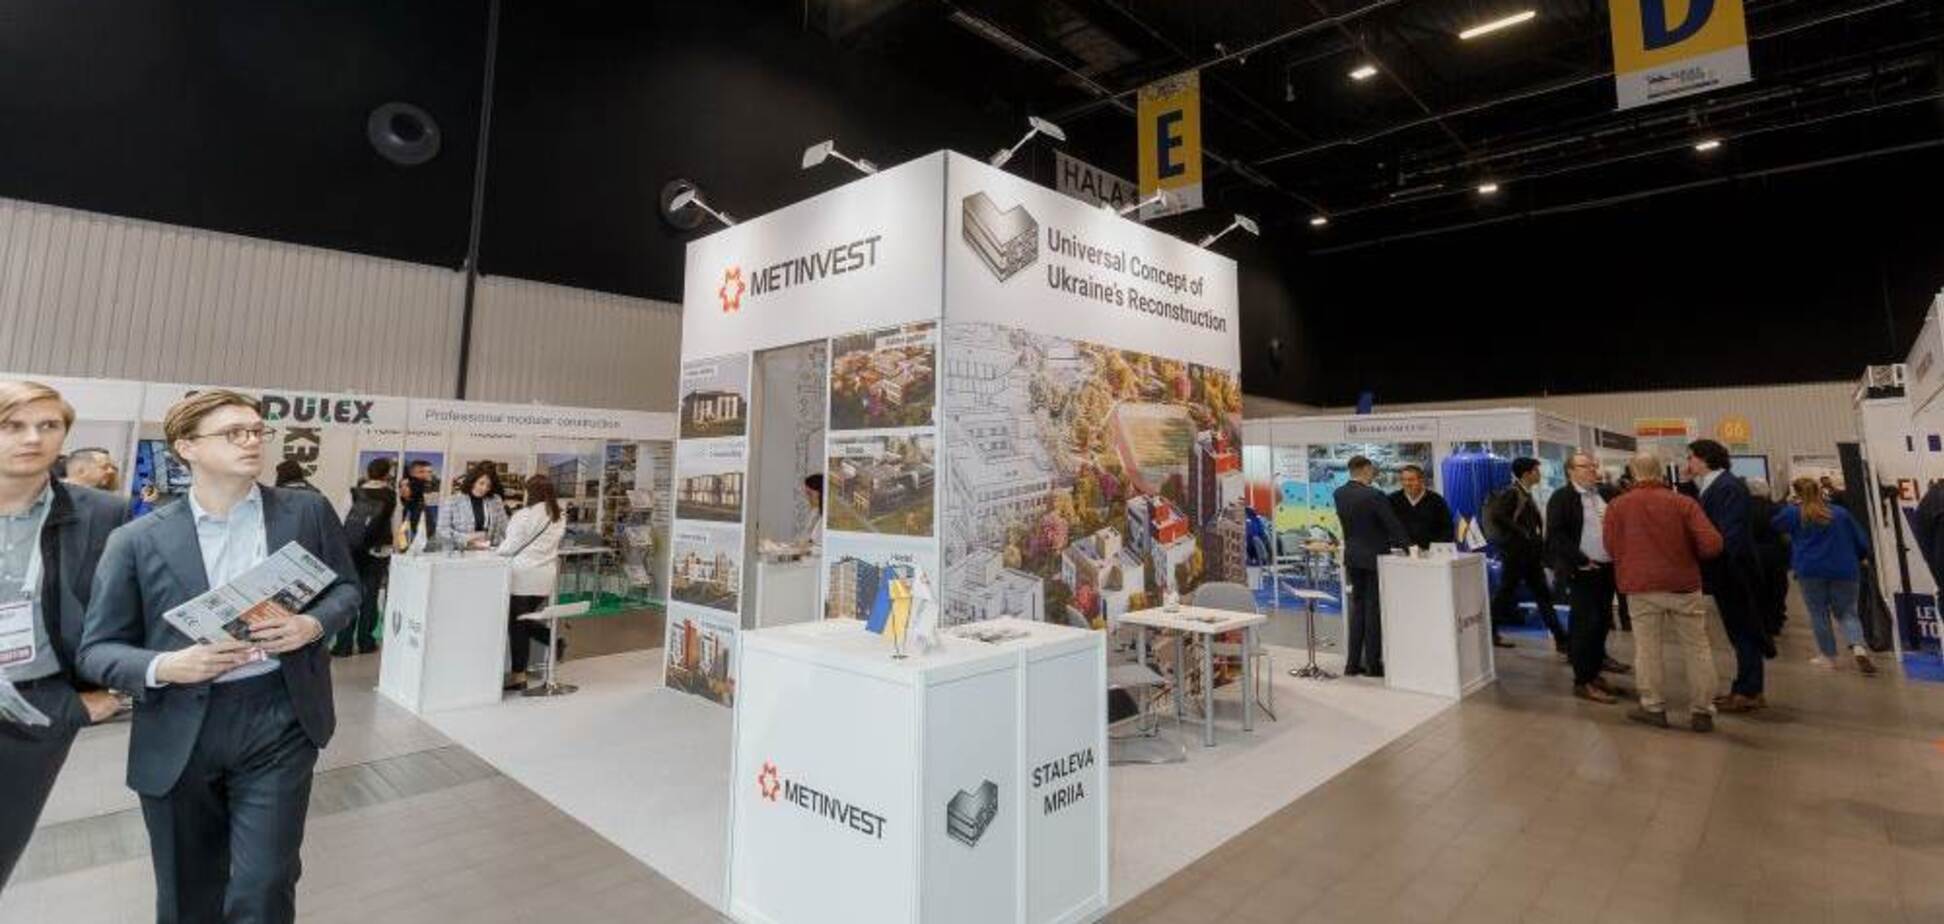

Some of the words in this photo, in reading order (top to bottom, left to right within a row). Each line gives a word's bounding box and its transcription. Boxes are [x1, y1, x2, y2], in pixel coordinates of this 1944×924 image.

[1157, 109, 1185, 179] E
[1064, 159, 1124, 208] HALA
[750, 235, 882, 296] METINVEST
[1048, 227, 1125, 273] Universal
[1130, 256, 1187, 295] Concept
[1190, 276, 1203, 297] of
[1048, 265, 1124, 307] Ukraine's
[1128, 287, 1227, 333] Reconstruction
[425, 409, 503, 424] Professional
[507, 412, 554, 425] modular
[1033, 747, 1094, 788] STALEVA
[785, 779, 887, 839] METINVEST
[1044, 781, 1085, 816] MRIIA
